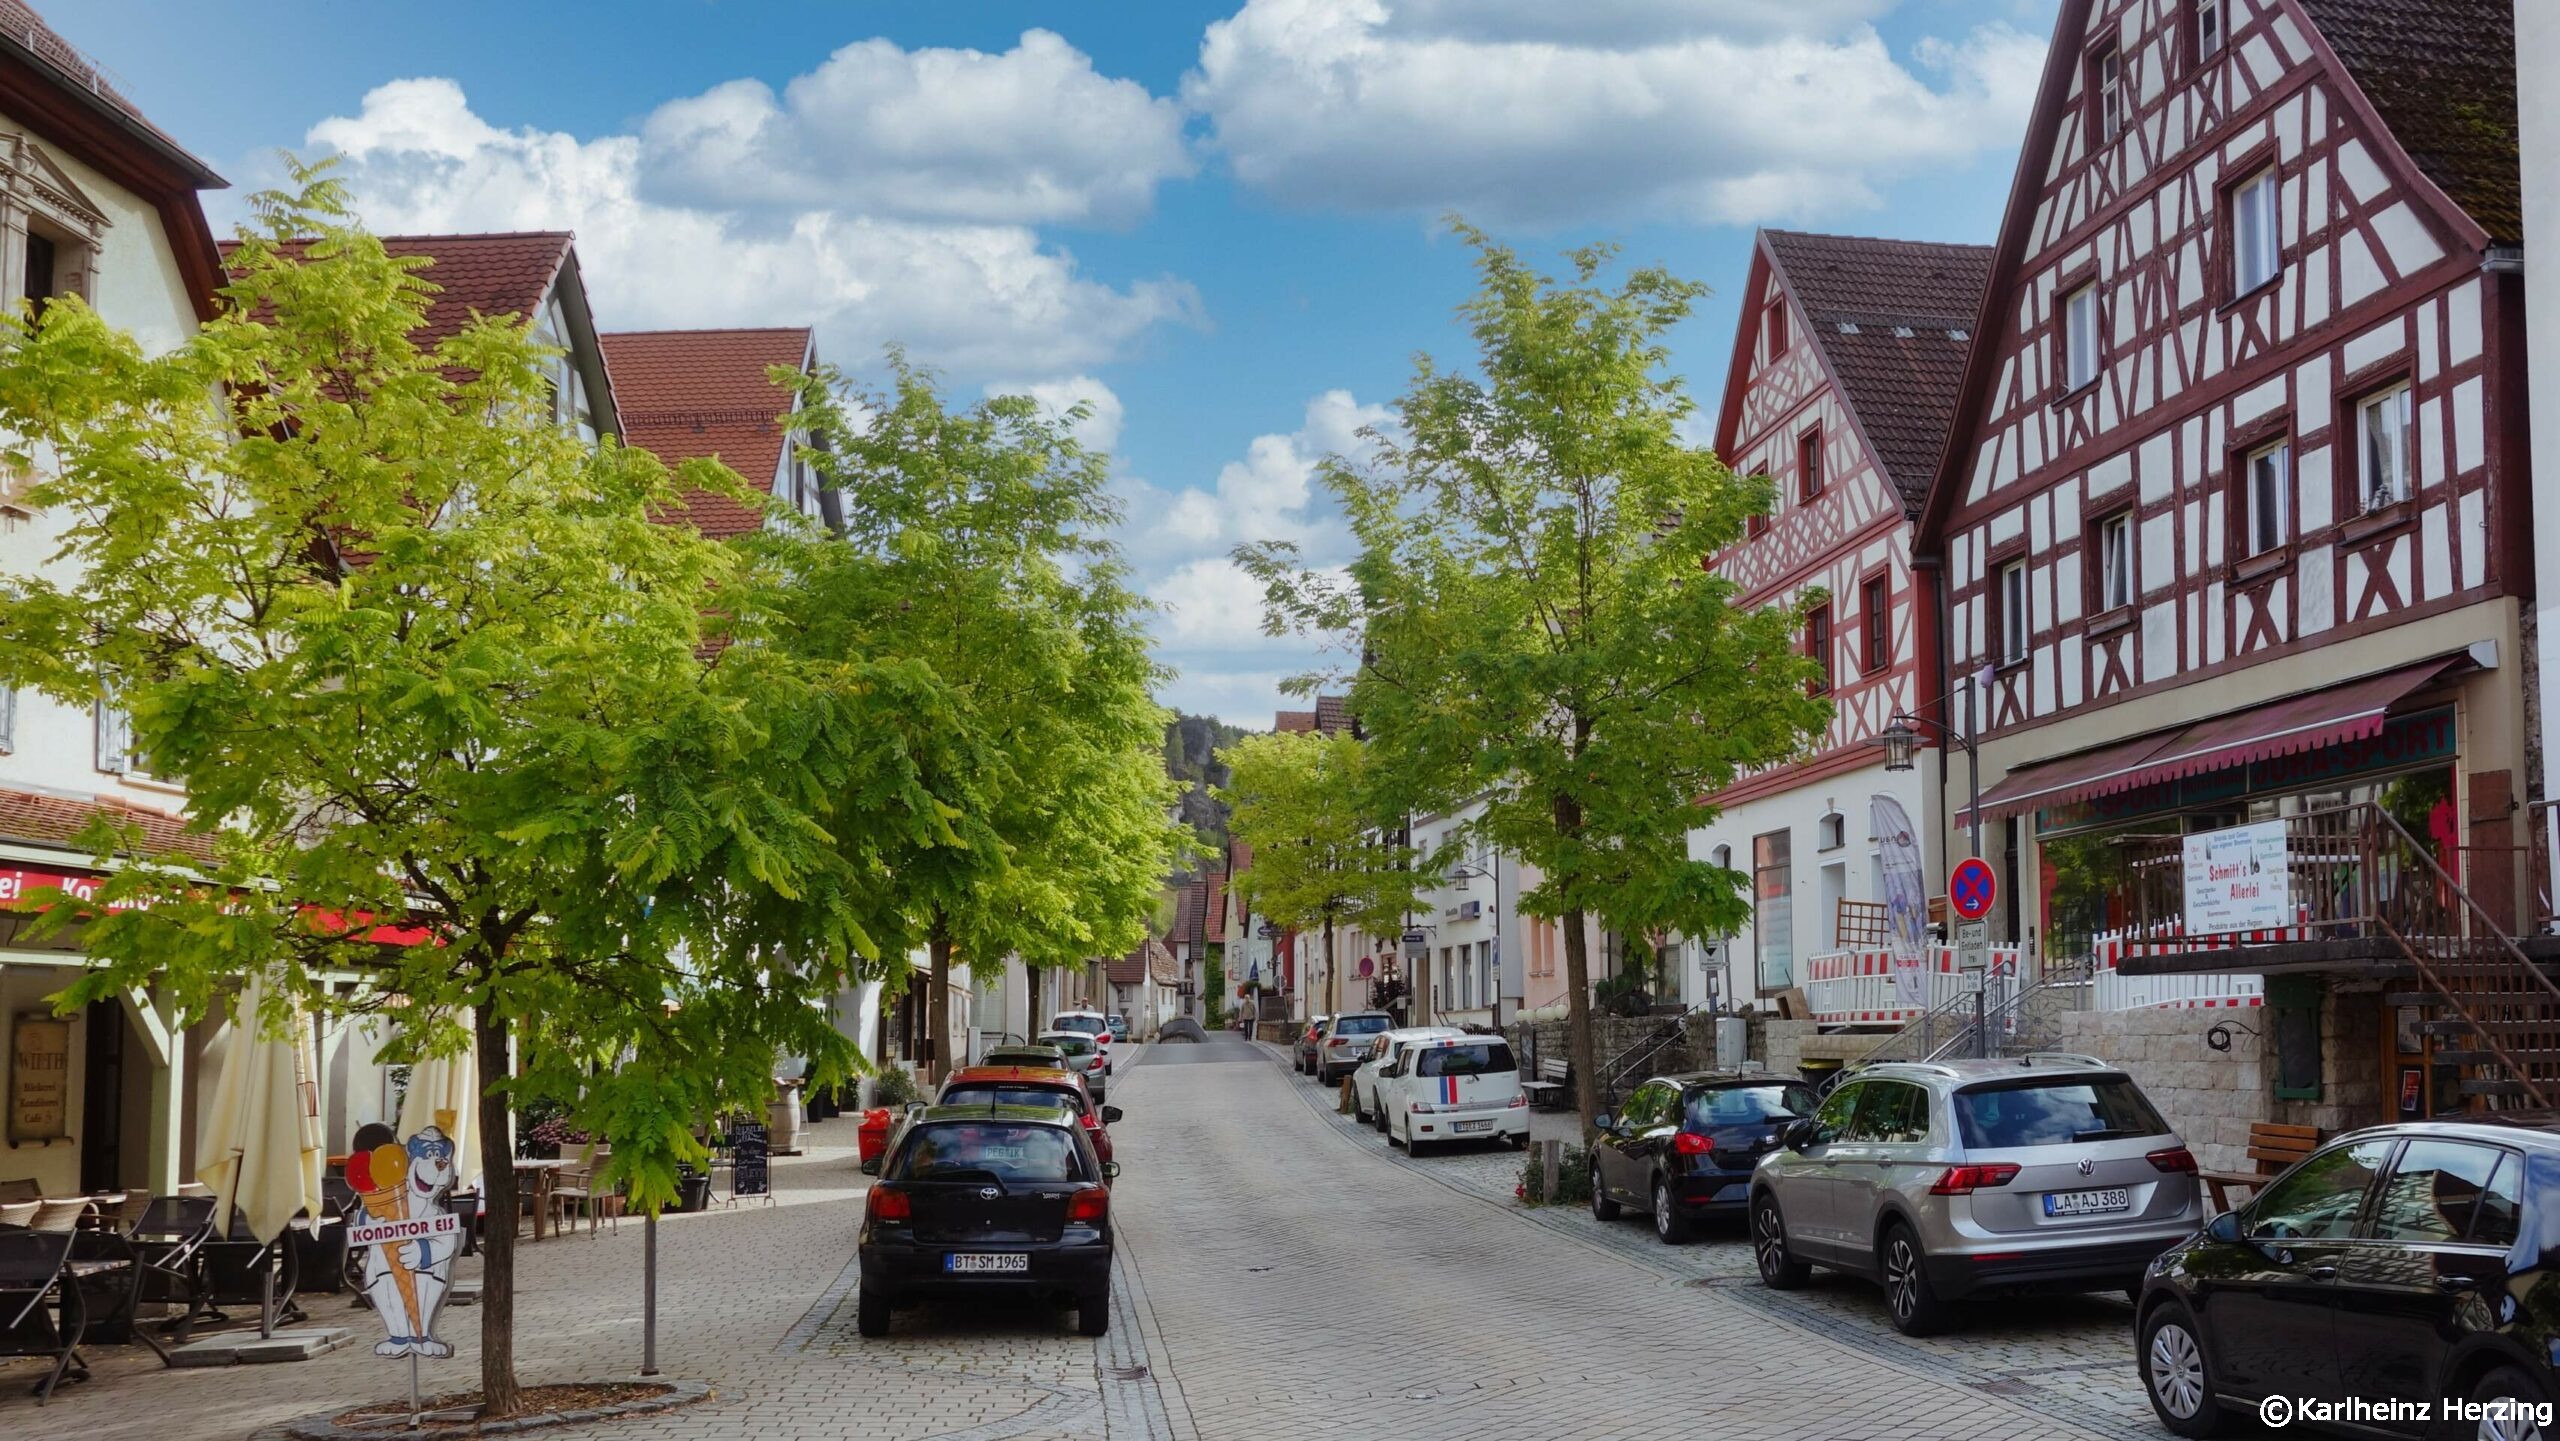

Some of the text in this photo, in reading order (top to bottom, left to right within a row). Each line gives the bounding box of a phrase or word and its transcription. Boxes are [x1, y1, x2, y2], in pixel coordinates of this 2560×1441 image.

[2255, 715, 2449, 785] JURA-SPORT
[2230, 882, 2259, 901] Allerlei
[1961, 941, 1983, 951] Entladen
[2053, 1190, 2126, 1210] LA AJ 388
[352, 1217, 454, 1242] KONDITOR EIS
[955, 1255, 1026, 1269] BT SM 1965
